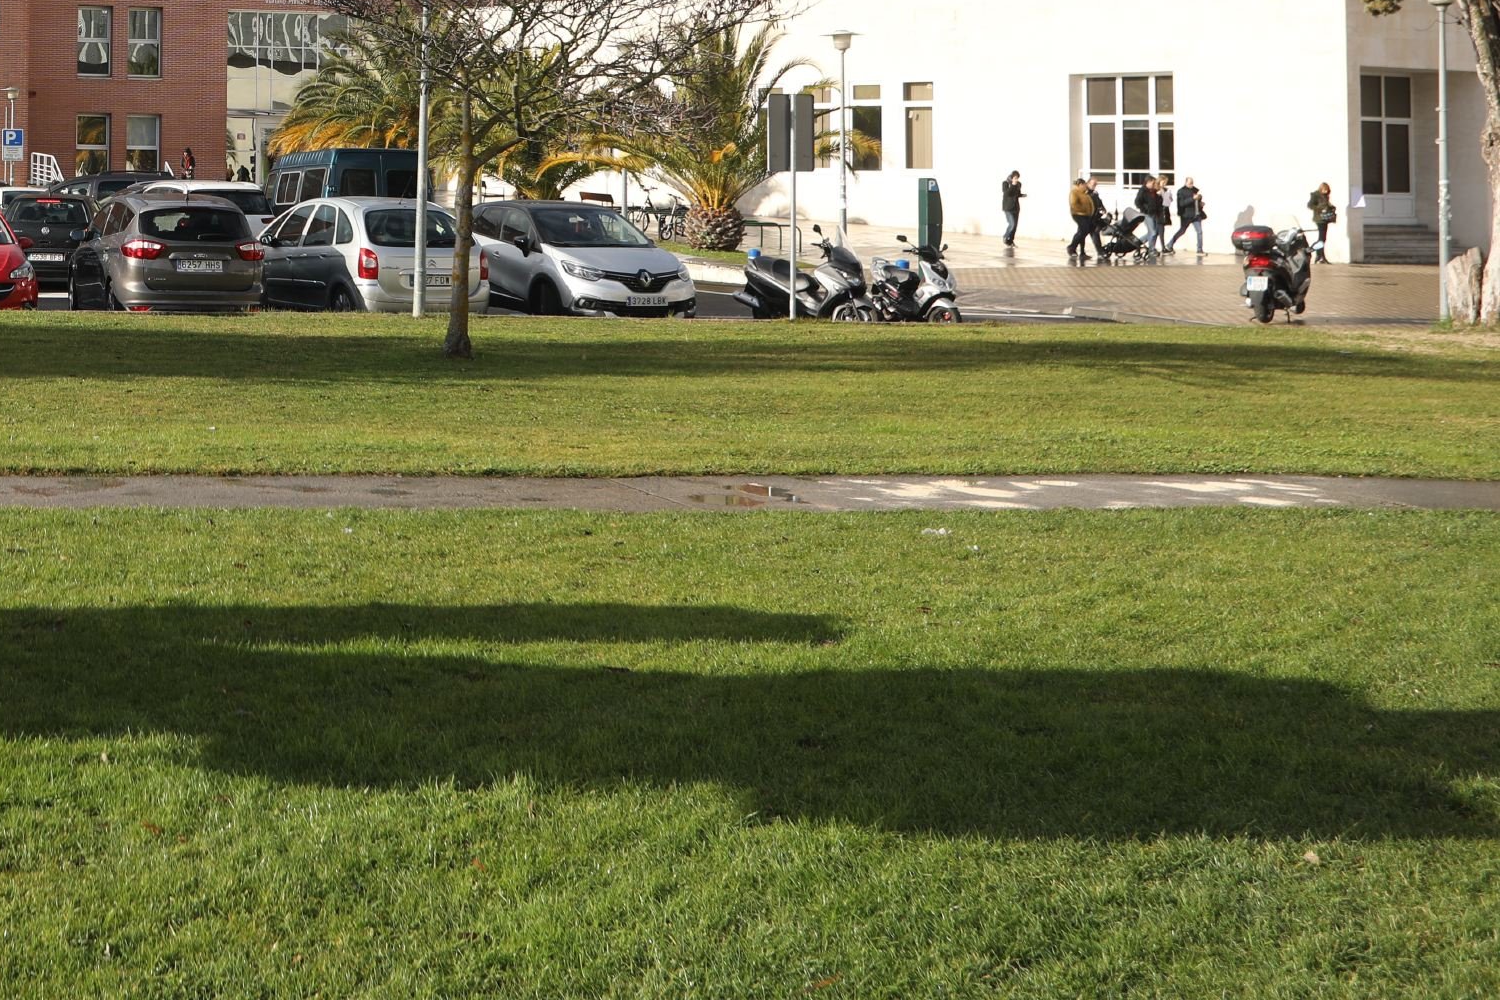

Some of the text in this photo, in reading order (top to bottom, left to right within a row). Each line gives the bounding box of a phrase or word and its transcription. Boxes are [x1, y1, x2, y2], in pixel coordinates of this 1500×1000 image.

[5, 131, 17, 145] P
[928, 180, 936, 191] P
[181, 260, 221, 269] 6257 HHS
[632, 296, 651, 305] 3728
